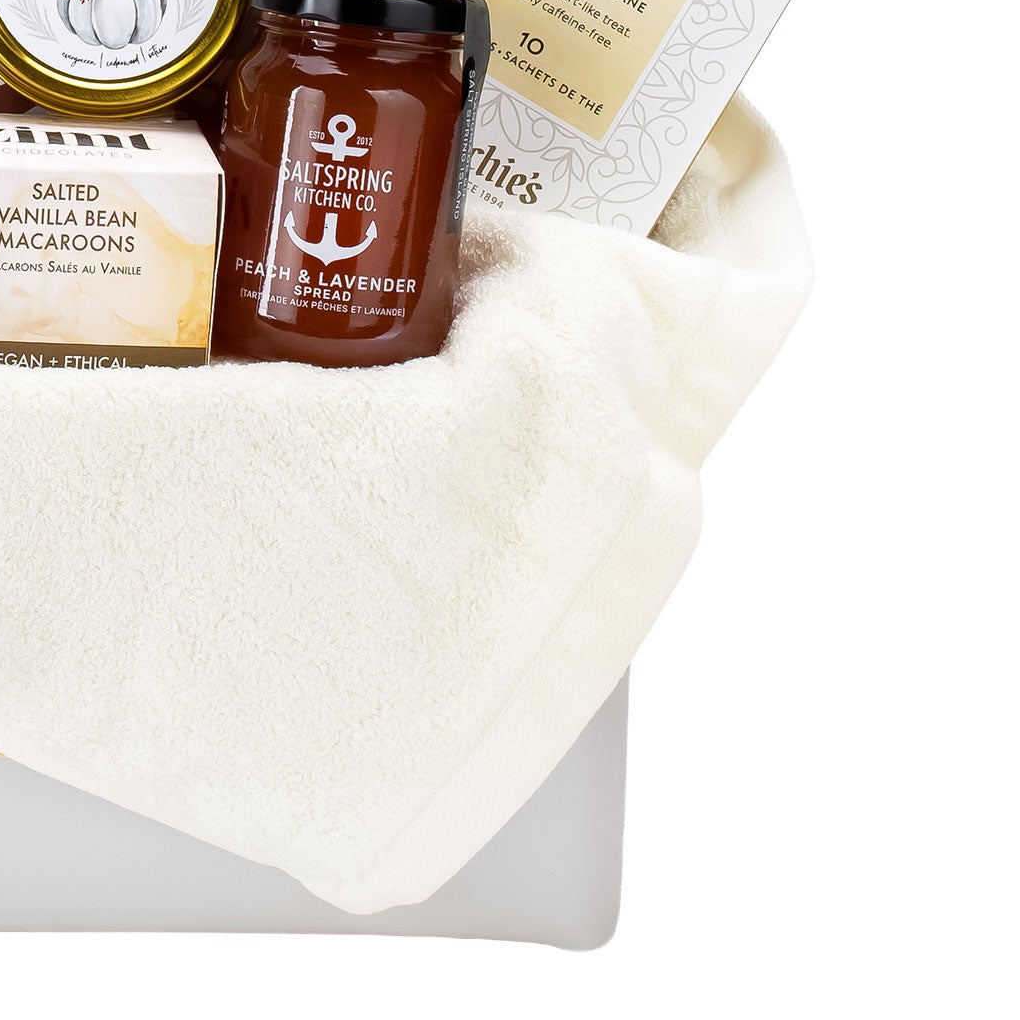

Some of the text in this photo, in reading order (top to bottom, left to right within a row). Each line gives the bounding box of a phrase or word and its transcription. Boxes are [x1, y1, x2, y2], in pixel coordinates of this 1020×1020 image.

[542, 0, 612, 50] caffeine-free.
[603, 13, 631, 39] treat.
[518, 32, 544, 56] 10
[503, 51, 605, 116] SACHETS DE THÉ
[309, 131, 373, 146] ESTD 2012
[2, 147, 133, 159] CHOCOLATES
[281, 158, 393, 194] SALTSPRING
[32, 183, 100, 202] SALTED
[293, 186, 377, 212] KITCHEN CO.
[480, 189, 504, 209] 1894
[85, 210, 137, 229] BEAN
[235, 257, 416, 293] PEACH & LAVENDER
[294, 285, 351, 302] SPREAD
[290, 298, 308, 309] AUX
[311, 299, 348, 313] PÊCHES
[351, 305, 362, 314] ET
